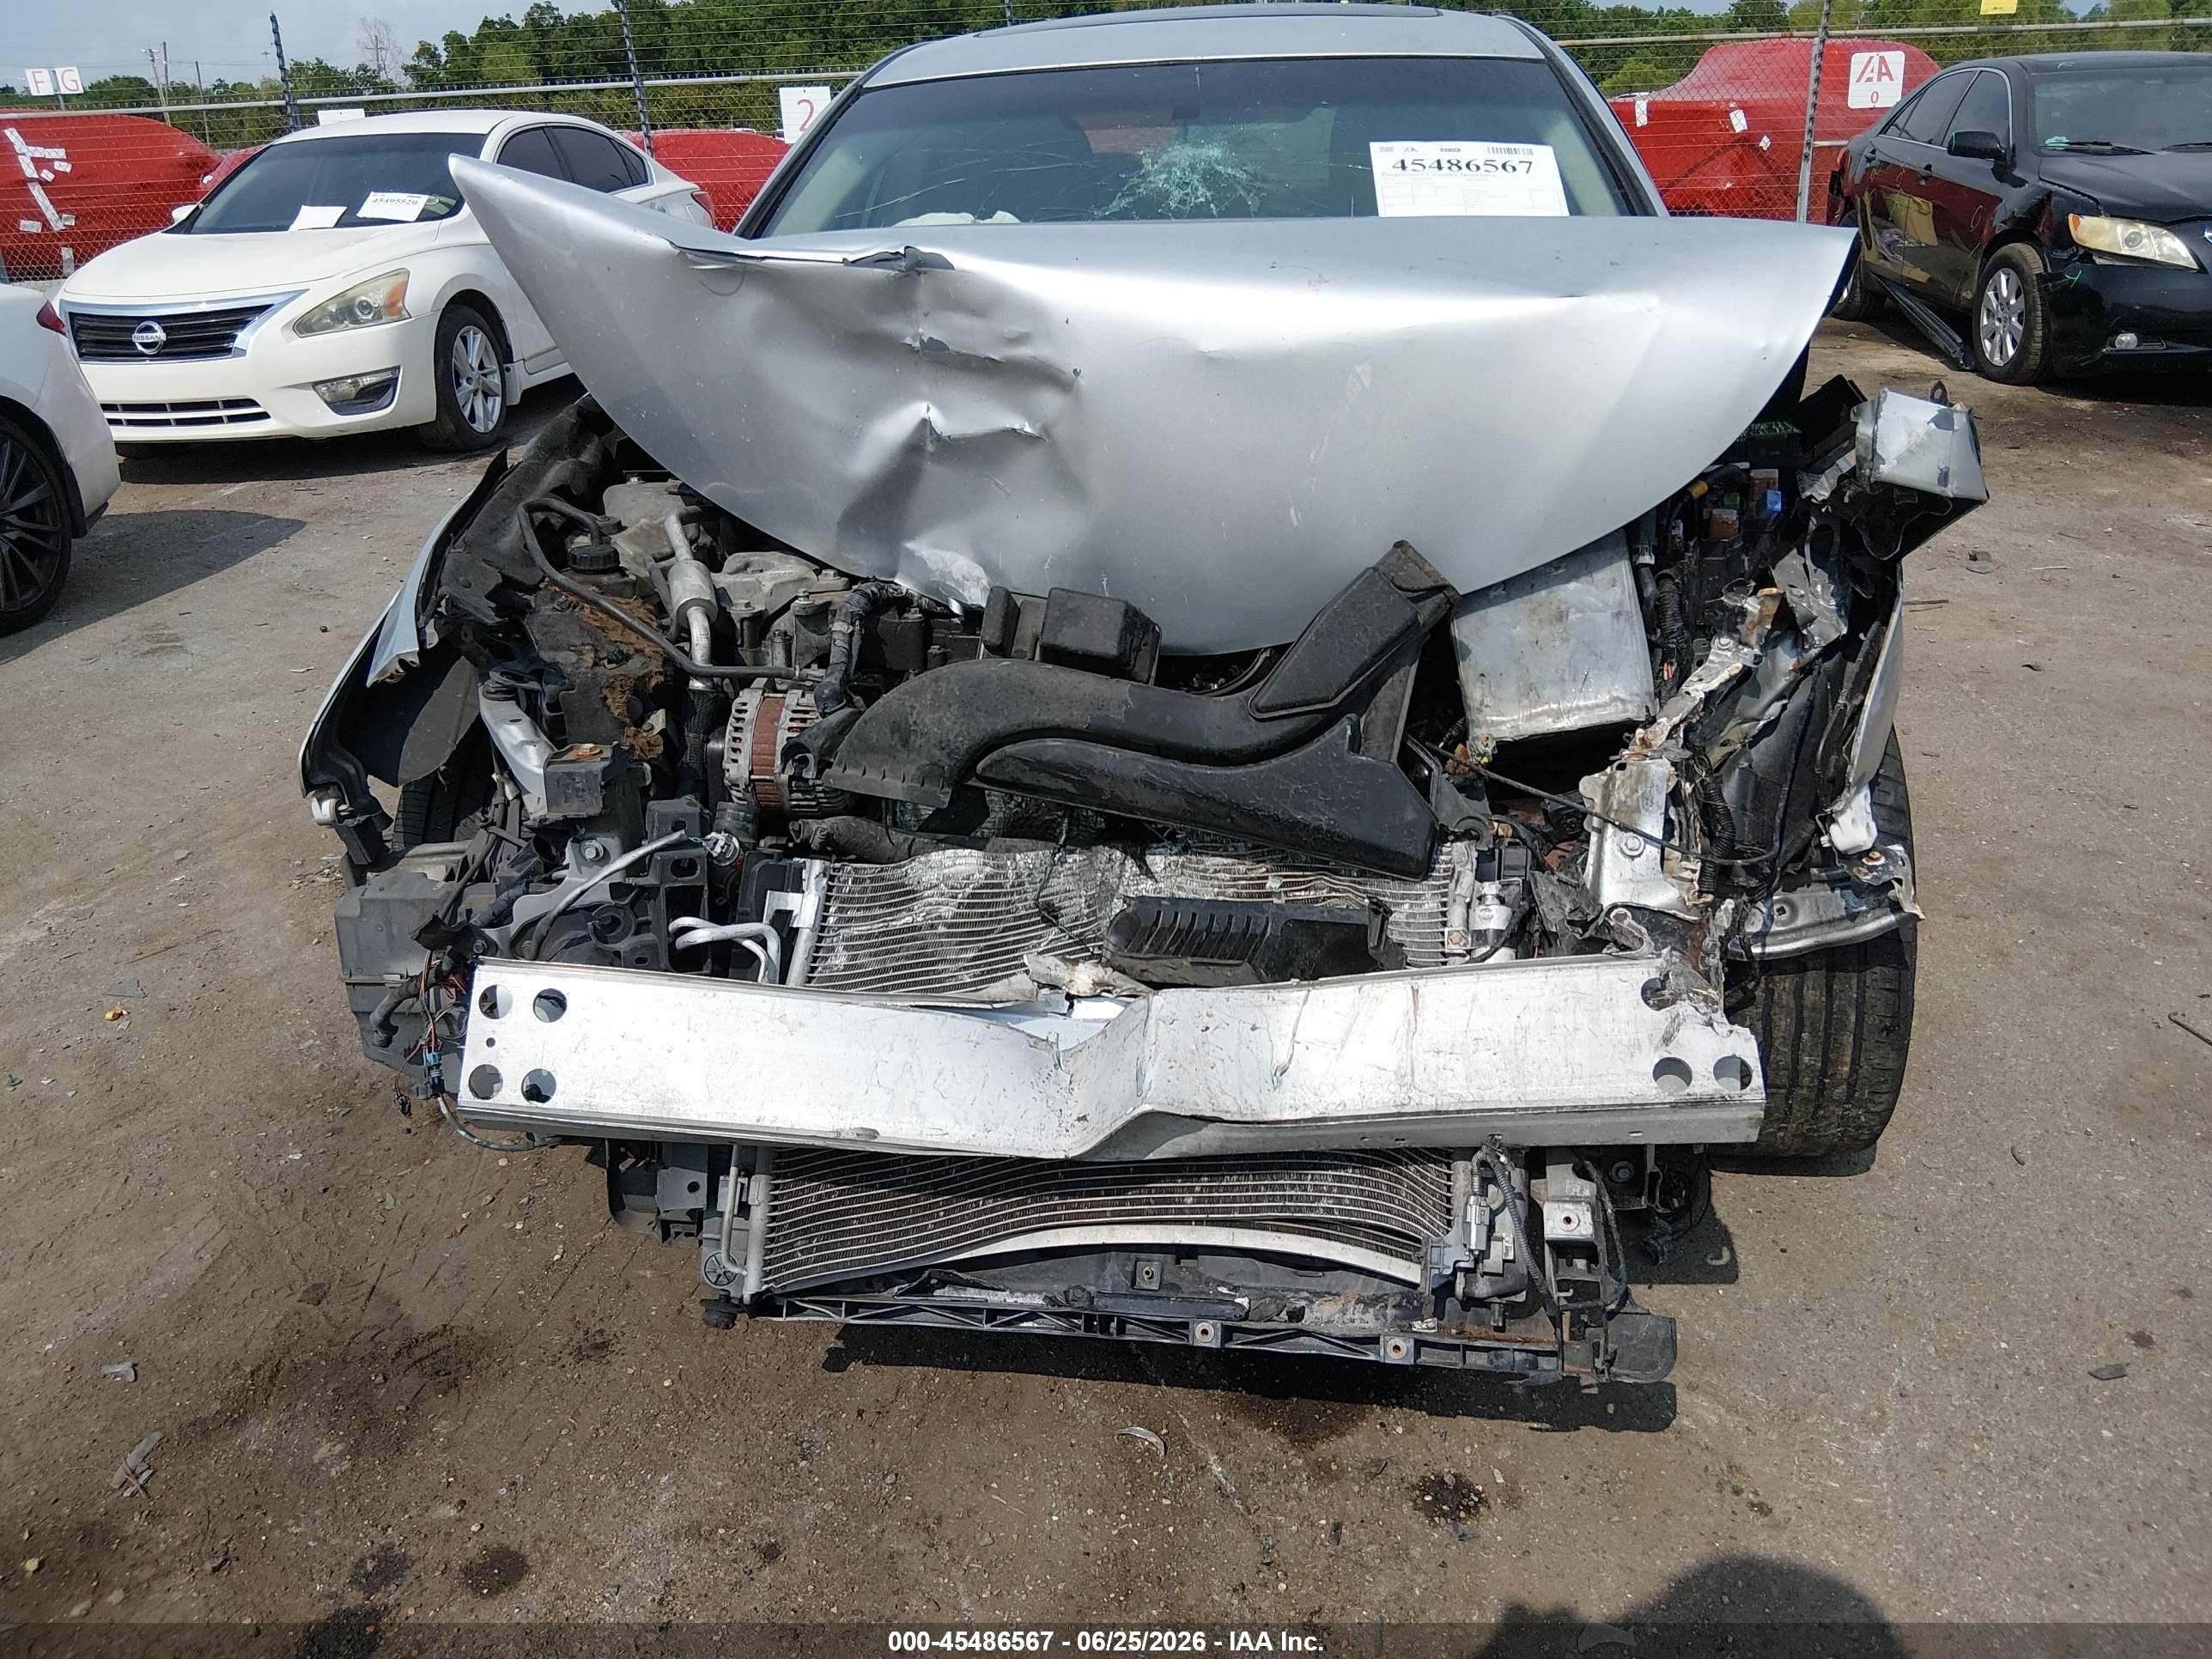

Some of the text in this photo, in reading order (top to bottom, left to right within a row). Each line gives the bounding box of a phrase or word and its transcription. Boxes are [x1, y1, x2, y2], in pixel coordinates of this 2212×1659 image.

[31, 70, 45, 94] F
[61, 69, 80, 92] G
[1391, 157, 1534, 175] 45486567
